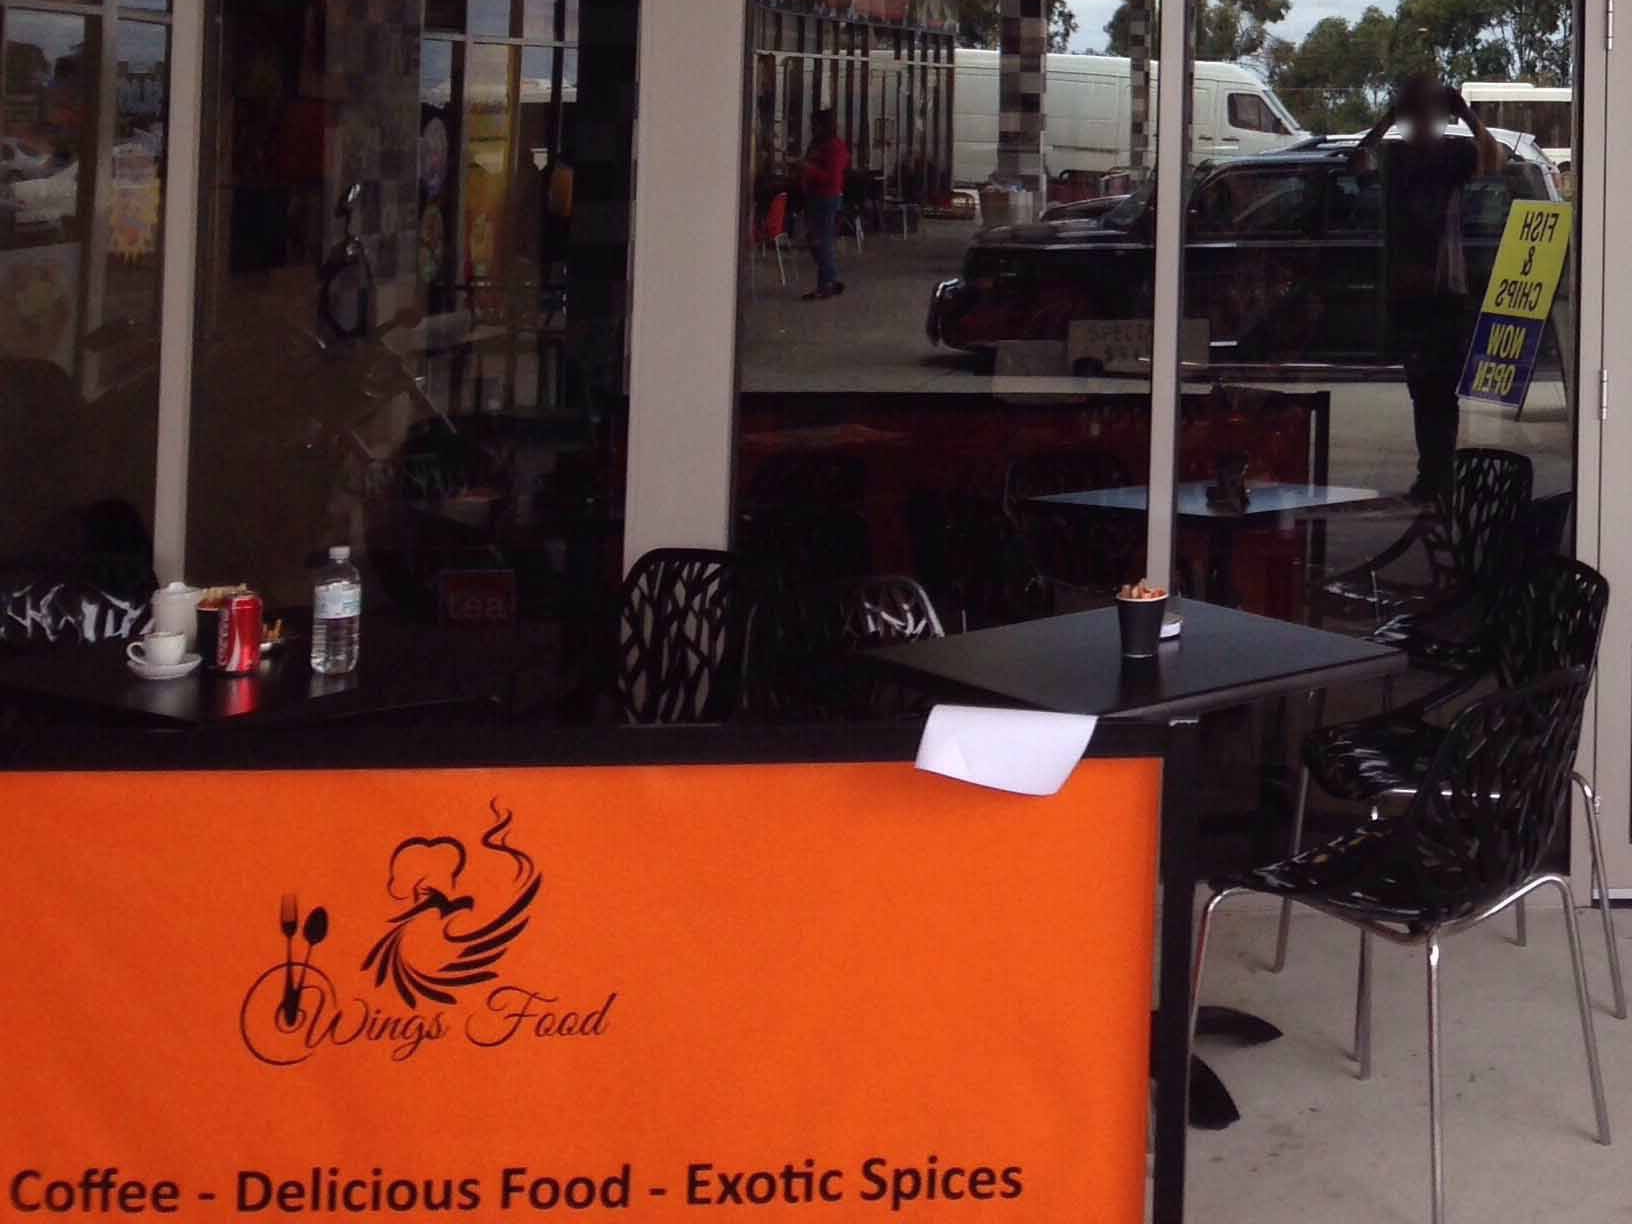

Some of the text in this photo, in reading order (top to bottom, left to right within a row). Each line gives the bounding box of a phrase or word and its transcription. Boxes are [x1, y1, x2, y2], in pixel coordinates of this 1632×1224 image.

[274, 985, 618, 1062] Wings Food
[9, 1167, 181, 1213] Coffee
[237, 1166, 481, 1213] Delicious
[501, 1164, 632, 1210] Food
[686, 1158, 843, 1206] Exotic
[859, 1155, 1023, 1211] Spices
